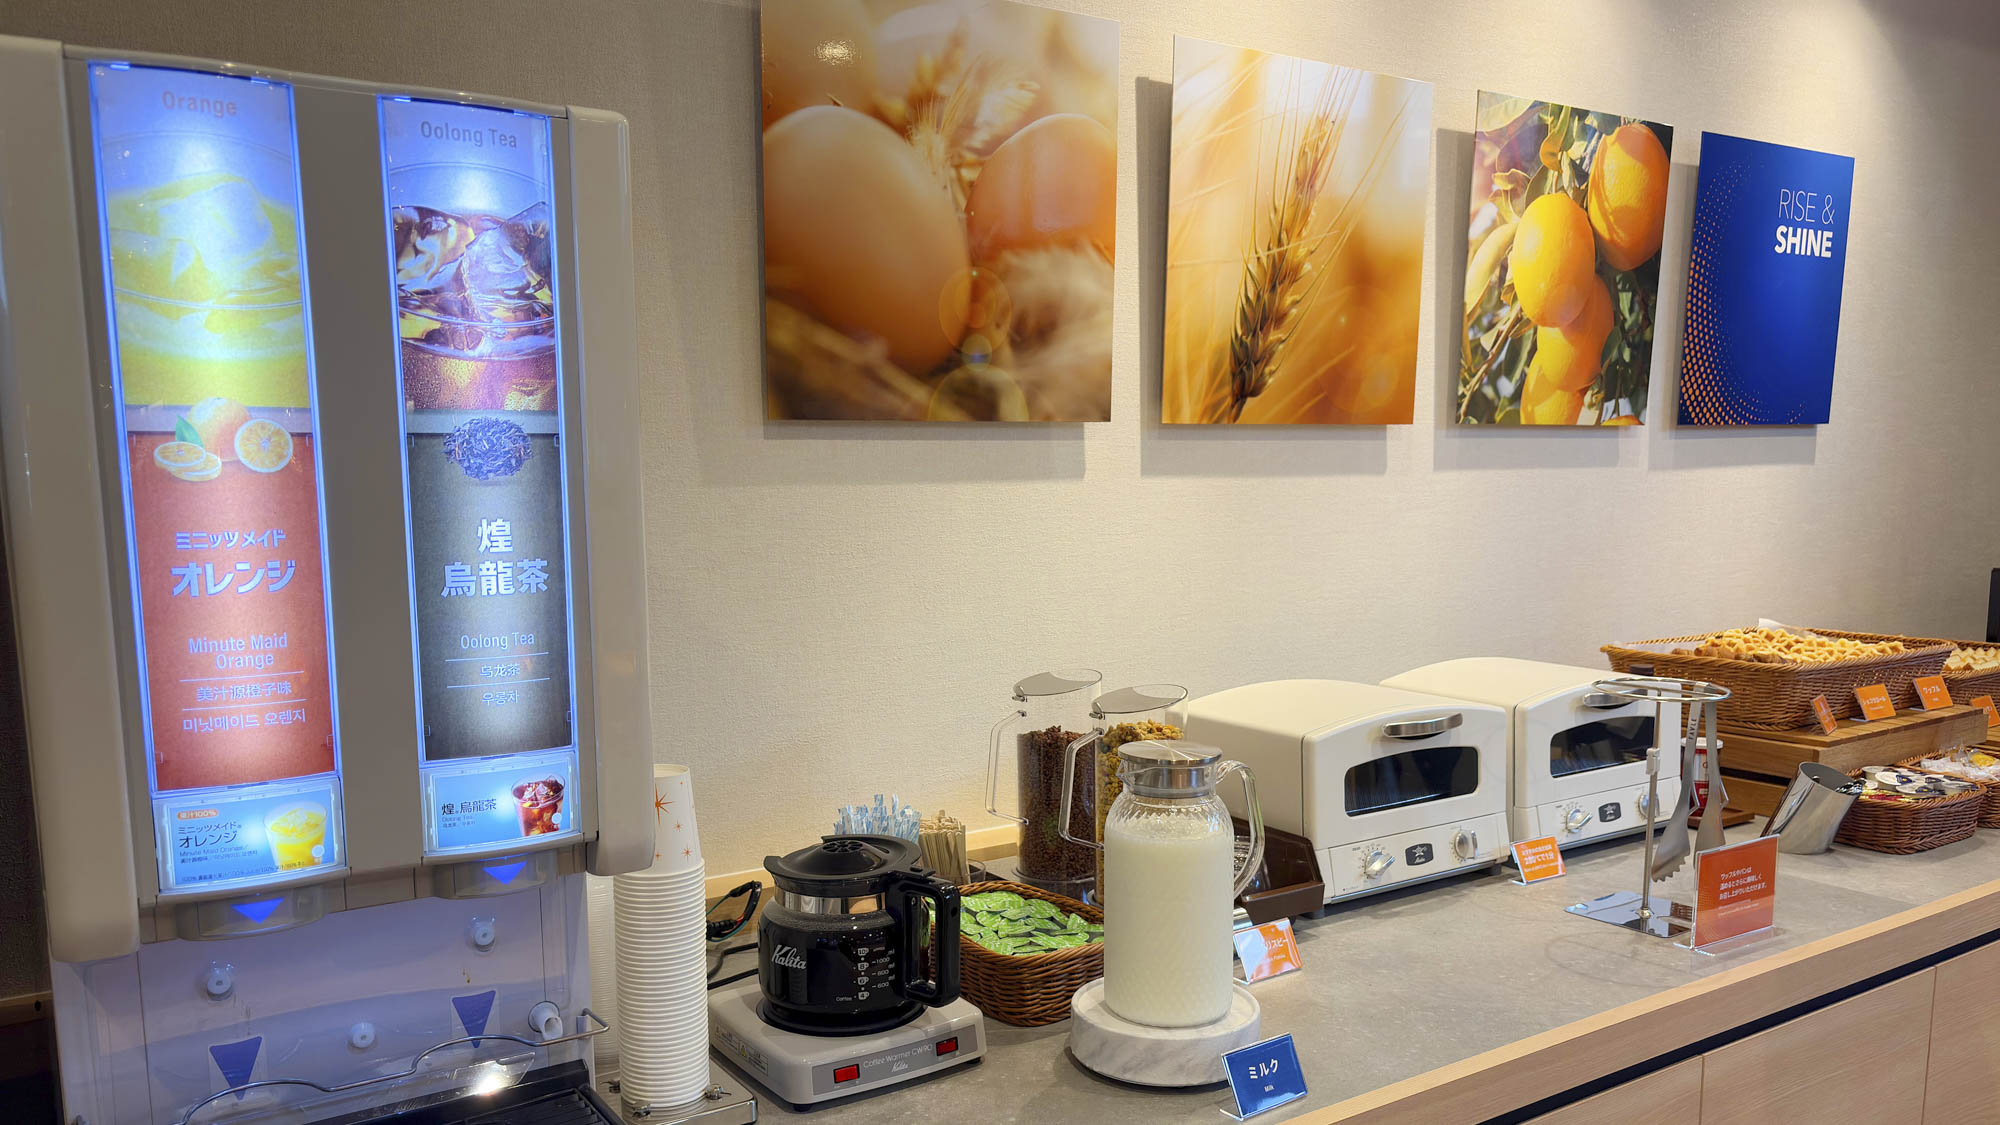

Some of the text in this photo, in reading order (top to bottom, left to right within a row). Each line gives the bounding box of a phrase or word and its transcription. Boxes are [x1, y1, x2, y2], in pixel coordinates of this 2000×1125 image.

[162, 91, 238, 118] Orange
[420, 121, 518, 149] Oolong Tea
[1779, 189, 1835, 225] RISE &
[1774, 225, 1833, 258] SHINE
[176, 529, 287, 550] ミニッツメイド
[477, 518, 513, 553] 煌
[171, 560, 296, 597] オレンジ
[441, 558, 549, 598] 烏龍茶
[188, 632, 288, 654] Minute Maid
[460, 632, 535, 649] Oolong Tea
[216, 652, 274, 669] Orange
[480, 663, 520, 678] 乌龙茶
[482, 690, 520, 705] 우롱차
[183, 708, 306, 734] 미닛메이드 오렌지
[179, 830, 237, 848] オレンジ
[771, 944, 807, 969] Kalita
[863, 1057, 886, 1068] Coffee
[886, 1051, 911, 1063] Warmer
[1249, 1058, 1279, 1079] ミルク
